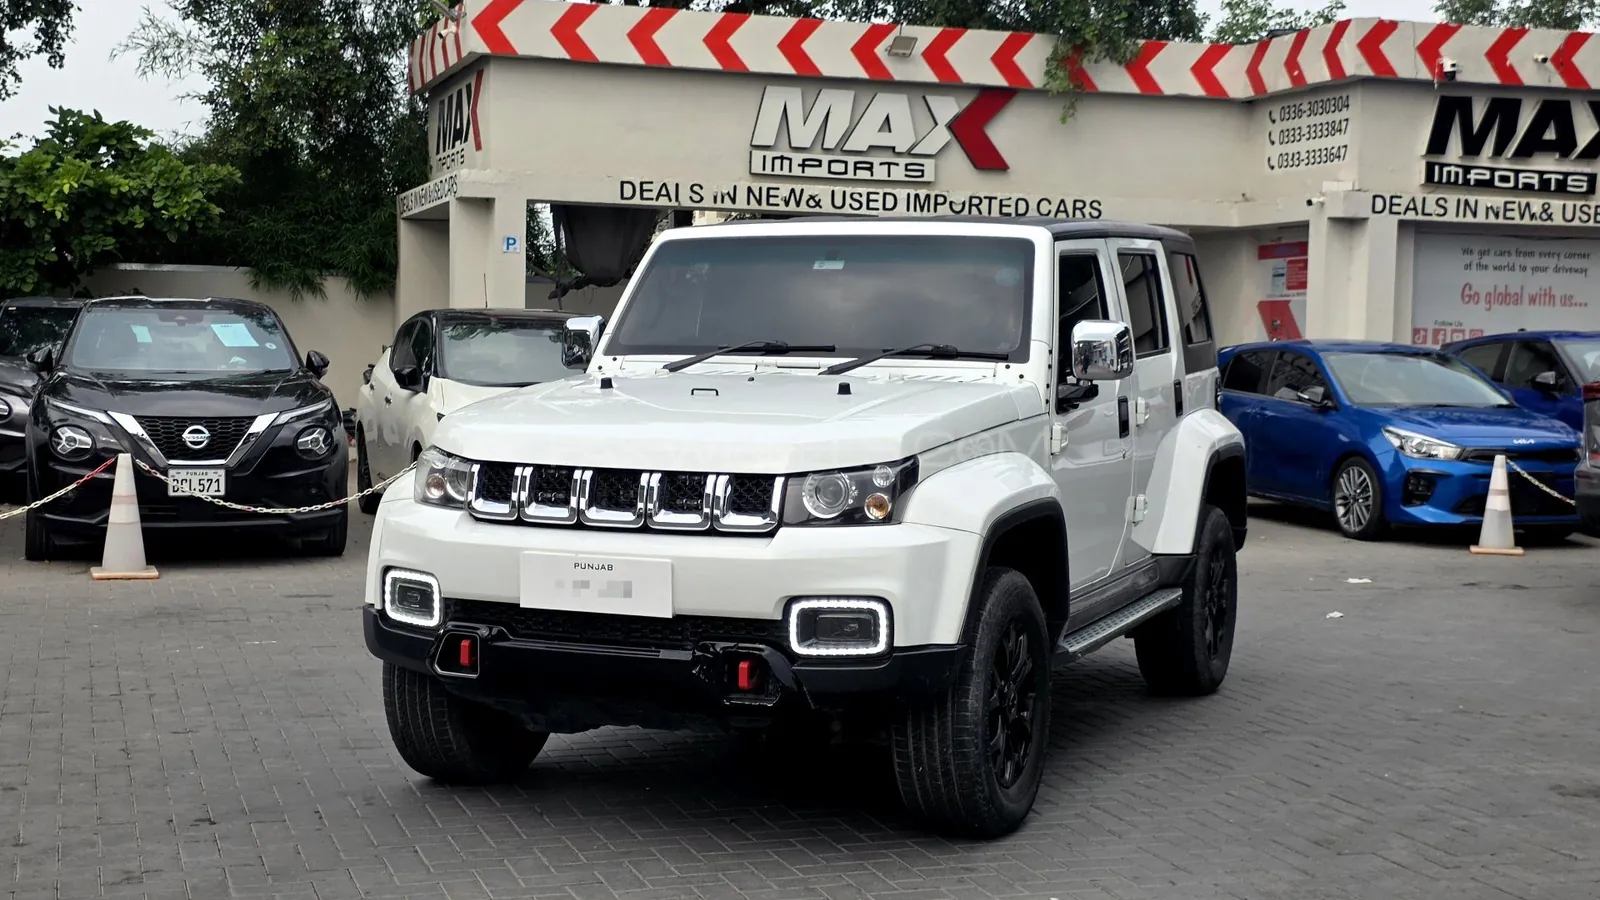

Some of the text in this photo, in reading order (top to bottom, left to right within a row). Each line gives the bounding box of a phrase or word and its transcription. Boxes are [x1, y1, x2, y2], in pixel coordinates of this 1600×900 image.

[436, 68, 484, 156] MAX
[1279, 94, 1350, 122] 0336-3030304
[750, 85, 1018, 172] MAX
[1278, 117, 1349, 146] 0333-3333847
[761, 154, 926, 179] IMPORTS
[1277, 144, 1348, 170] 0333-3333647
[1434, 164, 1589, 193] IMPORTS
[831, 189, 898, 211] USED
[906, 192, 1030, 217] IMPORTED
[1036, 197, 1103, 219] CARS
[1371, 194, 1448, 217] DEALS
[1455, 197, 1479, 219] IN
[506, 236, 517, 250] P
[1463, 261, 1588, 278] of the world to your driveway
[1460, 282, 1480, 305] Go
[1484, 284, 1524, 312] global
[1528, 285, 1556, 308] with
[573, 562, 614, 572] PUNJAB
